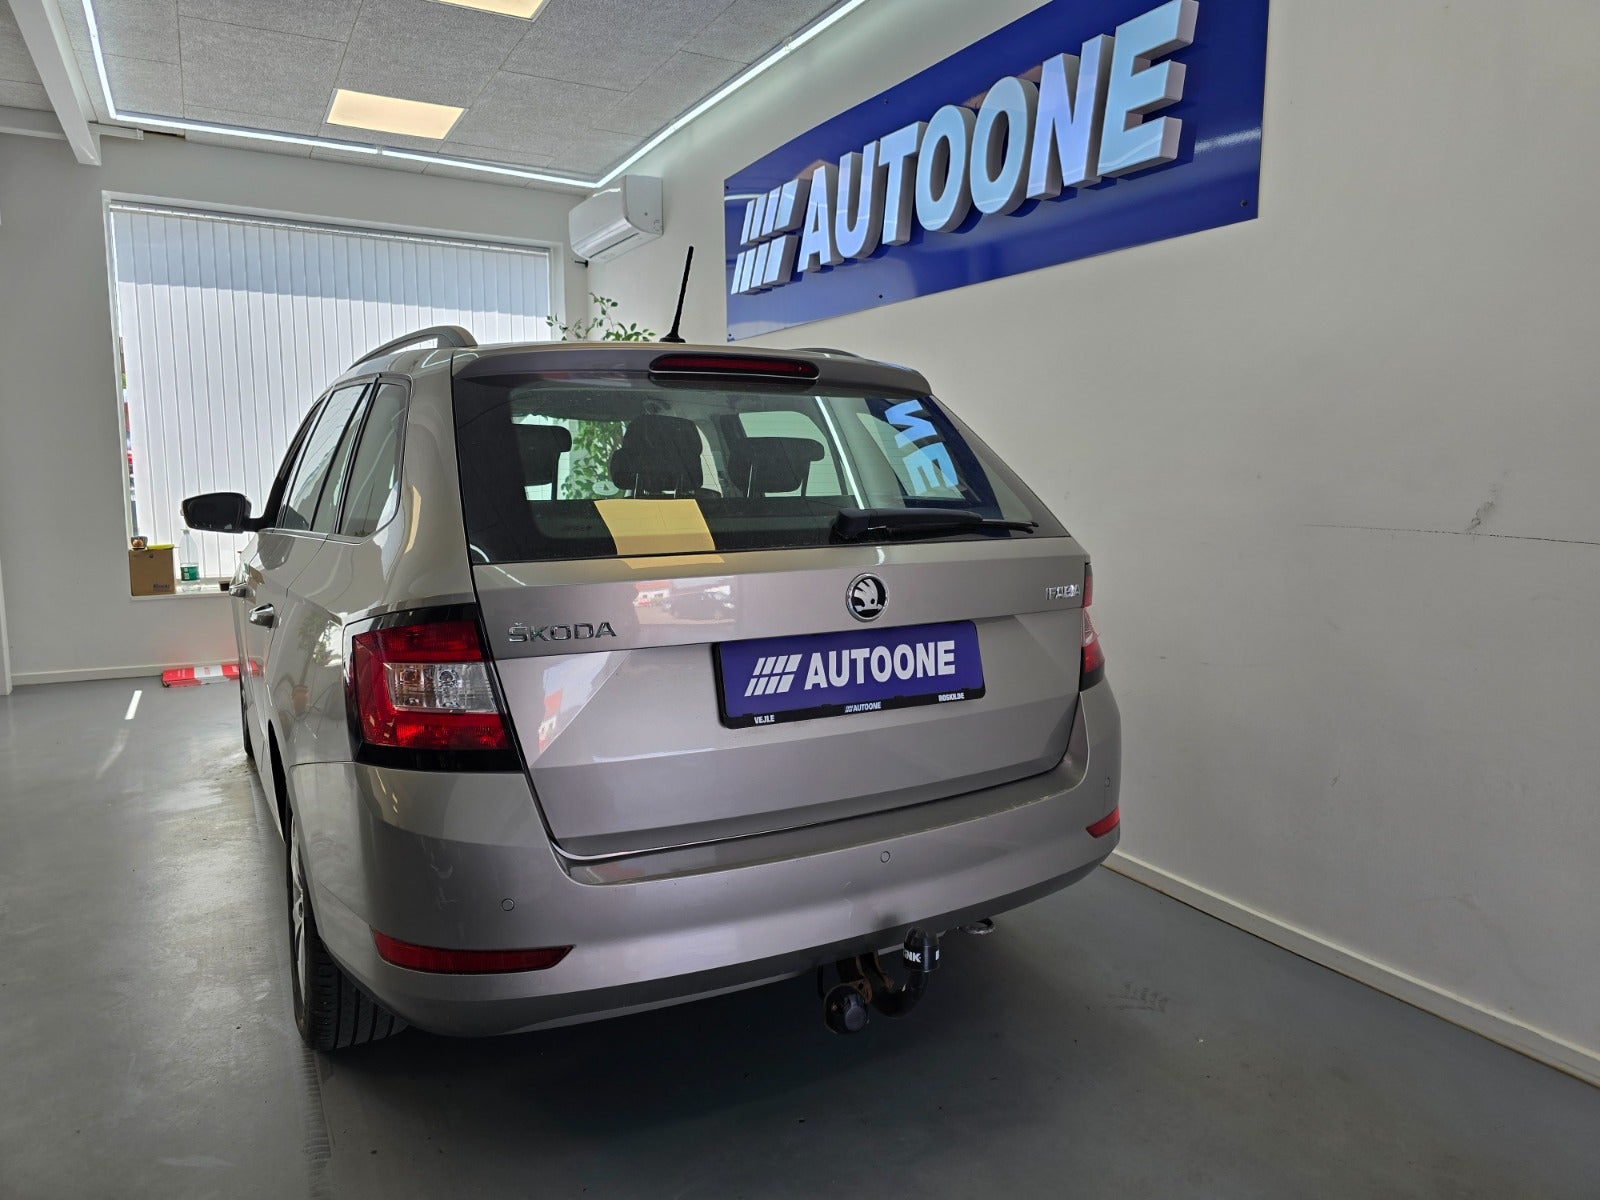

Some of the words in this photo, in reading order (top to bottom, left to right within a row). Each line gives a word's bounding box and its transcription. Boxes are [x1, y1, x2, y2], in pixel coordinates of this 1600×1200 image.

[797, 0, 1196, 273] AUTOONE
[508, 622, 617, 643] ŠKODA
[804, 640, 956, 690] AUTOONE
[853, 701, 882, 712] AUTOONE
[754, 714, 775, 725] VEJLE
